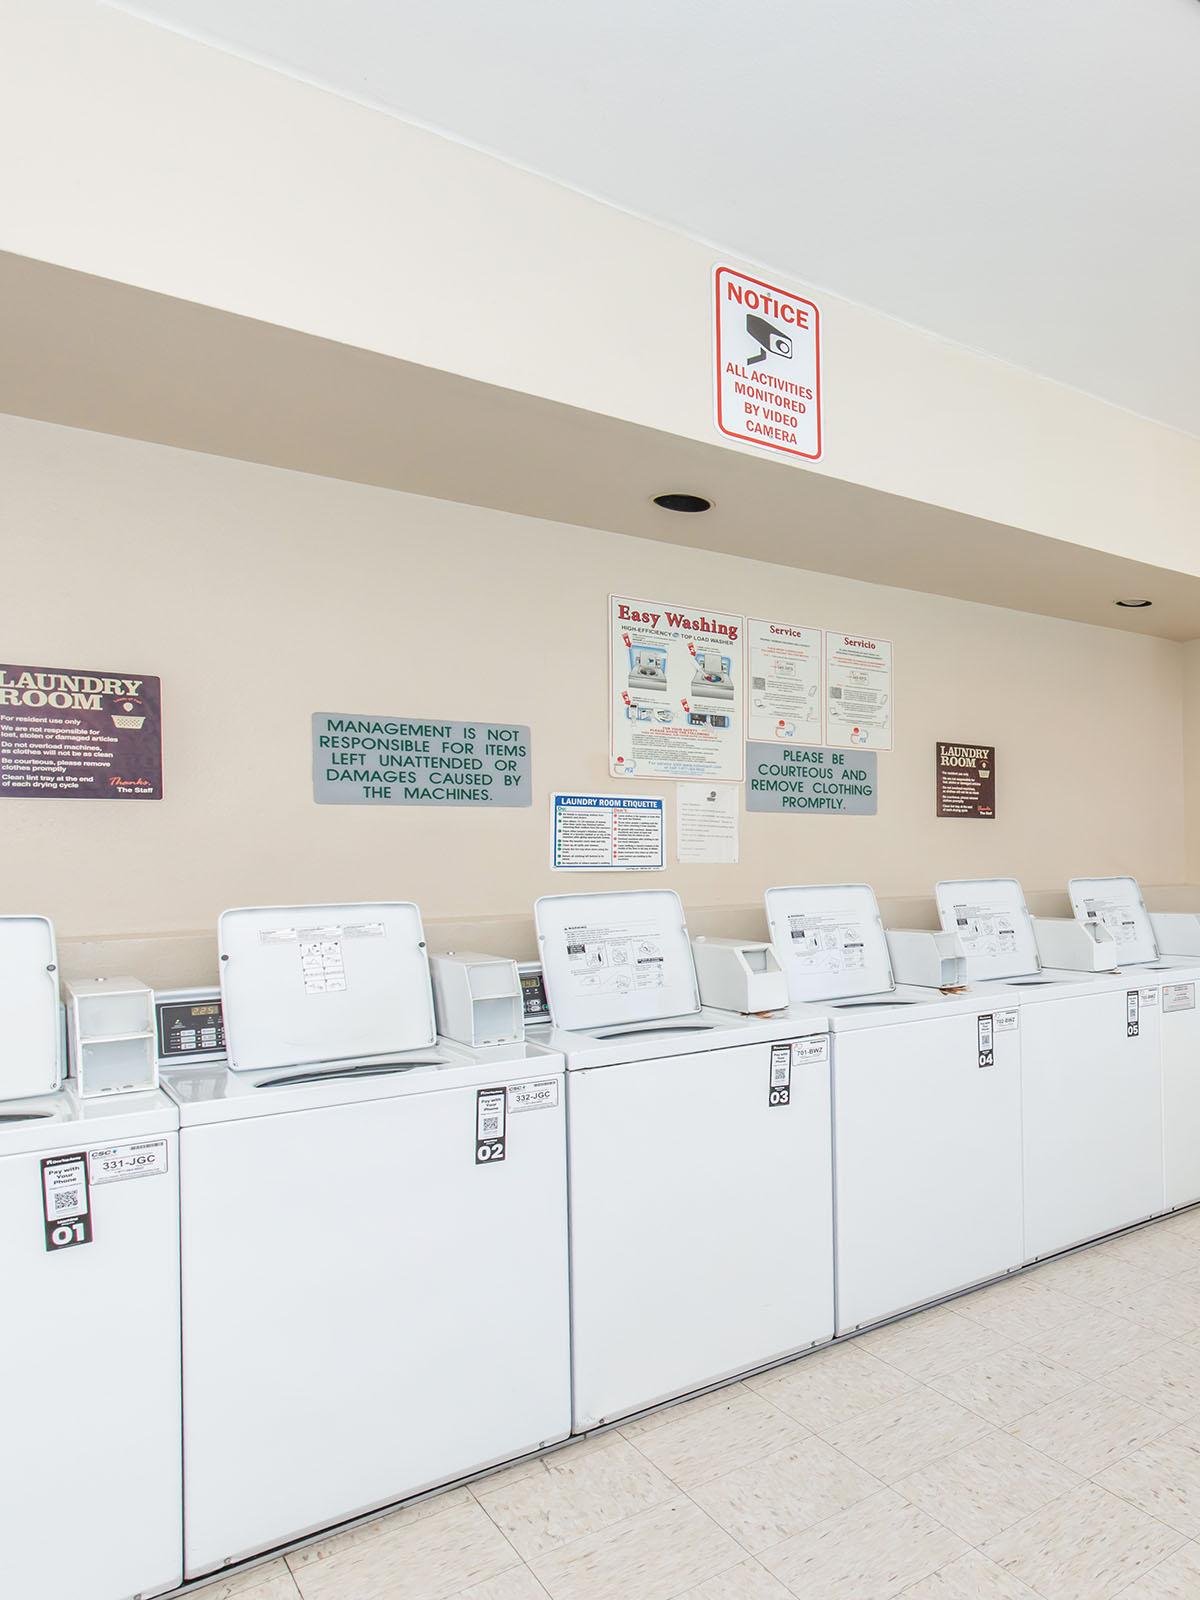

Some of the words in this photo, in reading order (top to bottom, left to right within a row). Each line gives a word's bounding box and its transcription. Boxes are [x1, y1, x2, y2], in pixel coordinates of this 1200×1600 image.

[728, 282, 809, 330] NOTICE
[726, 362, 748, 380] ALL
[751, 370, 813, 400] ACTIVITIES
[734, 381, 806, 414] MONITORED
[744, 401, 761, 415] BY
[762, 407, 798, 428] VIDEO
[746, 420, 797, 445] CAMERA
[618, 604, 661, 629] Easy
[665, 611, 738, 641] Washing
[769, 625, 801, 637] Service
[621, 625, 672, 637] HIGH-EFFICIENCY
[710, 638, 734, 646] WASHER
[844, 637, 876, 649] Servicio
[0, 671, 143, 696] LAUNDRY
[0, 688, 103, 710] ROOM
[327, 719, 452, 738] MANAGEMENT
[464, 727, 476, 739] IS
[488, 729, 520, 742] NOT
[319, 735, 430, 753] RESPONSIBLE
[442, 742, 474, 754] FOR
[486, 744, 526, 758] ITEMS
[940, 746, 990, 760] LAUNDRY
[332, 752, 366, 766] LEFT
[379, 755, 483, 770] UNATTENDED
[494, 759, 518, 772] OR
[783, 750, 824, 764] PLEASE
[832, 754, 844, 765] BE
[940, 756, 976, 768] ROOM
[326, 769, 416, 784] DAMAGES
[429, 772, 494, 786] CAUSED
[504, 775, 522, 786] BY
[758, 764, 834, 780] COURTEOUS
[842, 770, 867, 781] AND
[363, 786, 392, 799] THE
[404, 787, 494, 801] MACHINES.
[751, 779, 804, 792] REMOVE
[812, 782, 872, 796] CLOTHING
[561, 798, 597, 806] LAUNDRY
[622, 800, 658, 808] ETIQUETTE
[782, 796, 846, 810] PROMPTLY.
[1128, 1025, 1138, 1036] 05
[980, 1054, 992, 1066] 04
[516, 1091, 550, 1102] 332-JGC
[770, 1090, 788, 1104] 03
[477, 1143, 504, 1161] 02
[102, 1154, 156, 1170] 331-JGC
[52, 1222, 85, 1246] 01
